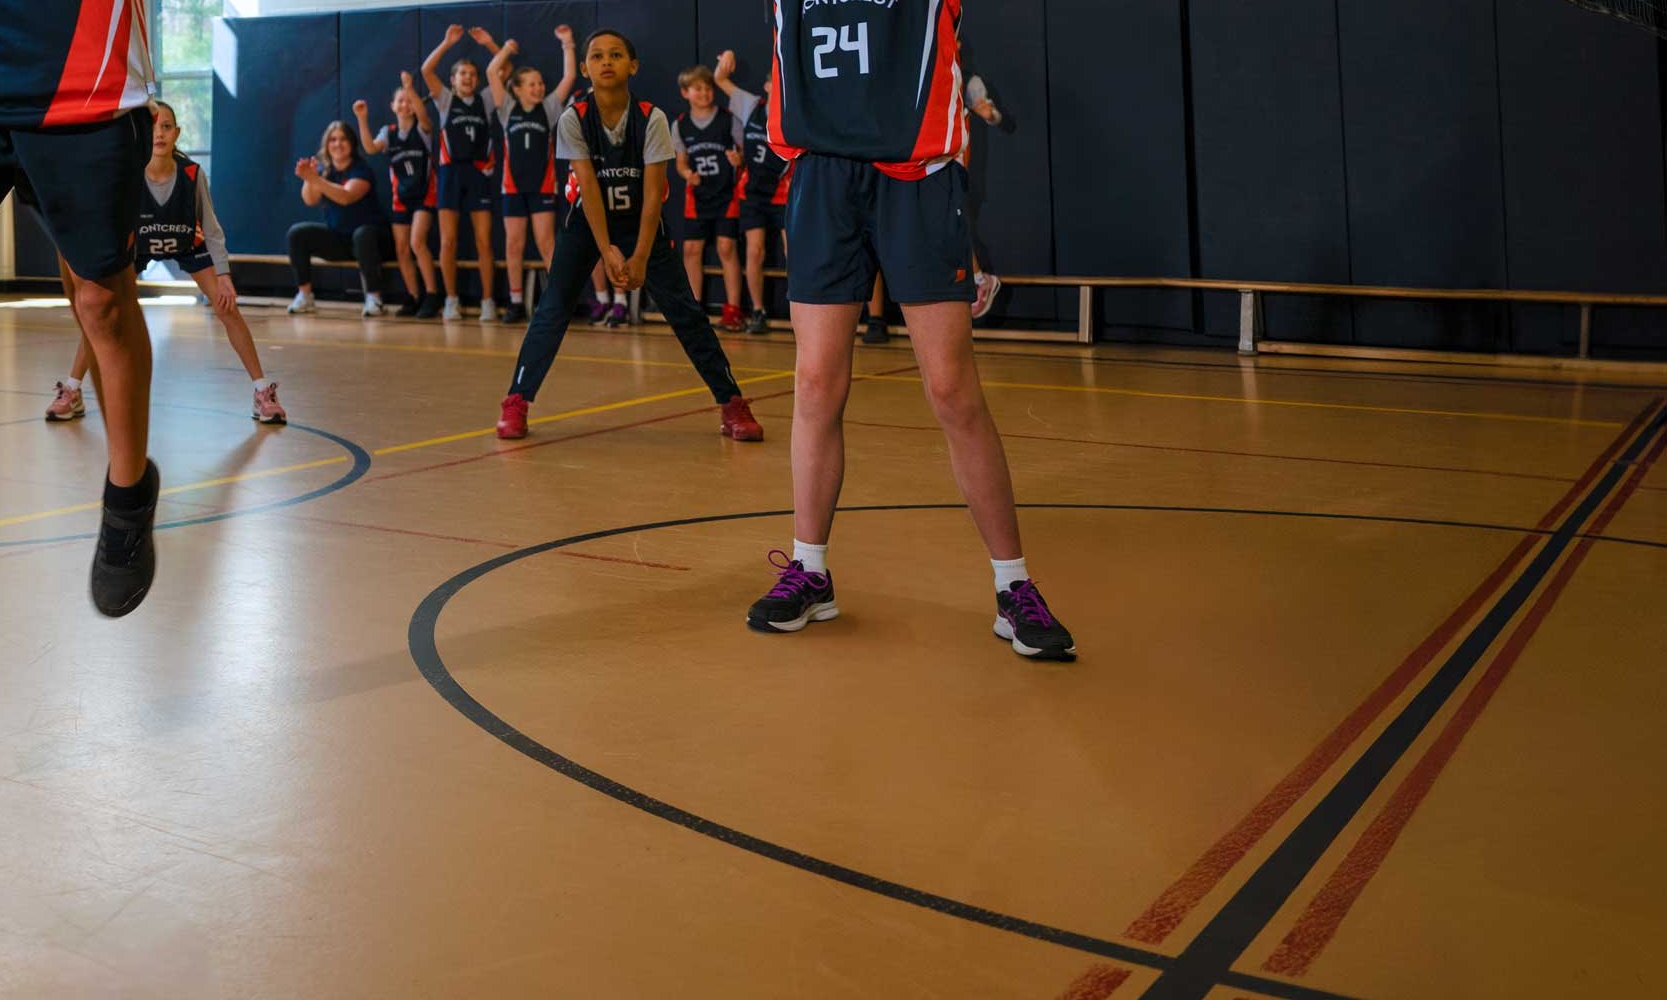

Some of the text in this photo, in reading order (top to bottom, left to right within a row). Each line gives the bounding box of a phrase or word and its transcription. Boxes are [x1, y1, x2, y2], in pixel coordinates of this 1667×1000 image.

[812, 22, 870, 79] 24
[465, 125, 475, 142] 4
[524, 132, 530, 149] 1
[753, 144, 766, 163] 3
[695, 155, 719, 176] 25
[608, 185, 631, 210] 15
[139, 223, 194, 235] ONTCREST
[149, 238, 177, 254] 22
